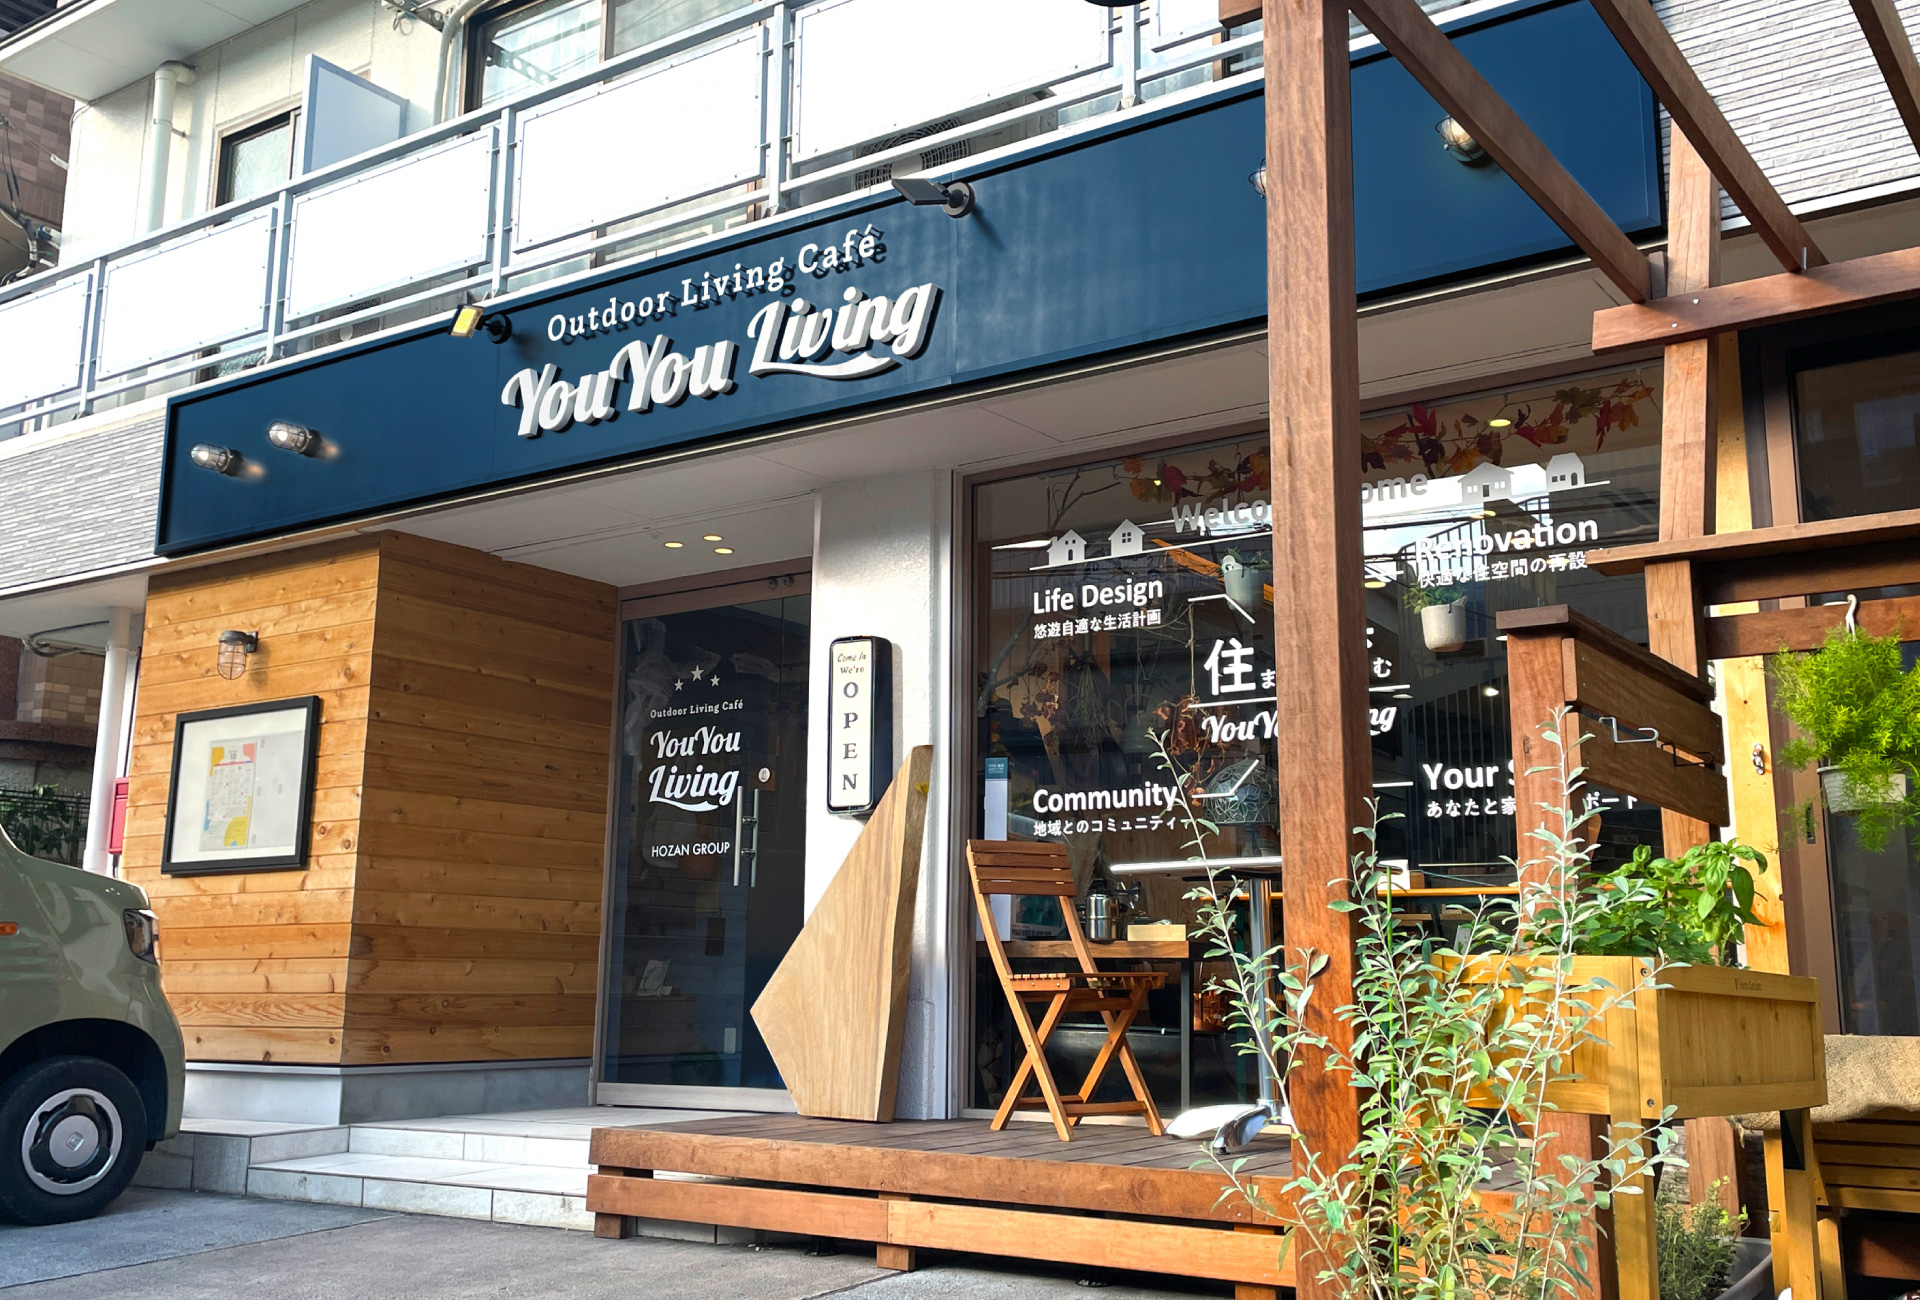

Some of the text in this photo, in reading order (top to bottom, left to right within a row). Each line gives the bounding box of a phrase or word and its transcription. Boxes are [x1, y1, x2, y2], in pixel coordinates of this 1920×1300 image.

[548, 223, 876, 342] Outdoor Living Café
[747, 283, 940, 378] Living
[1171, 473, 1428, 534] Welco ome
[1415, 518, 1599, 563] Renovation
[1417, 549, 1603, 589] 快適な住空間の再設
[1033, 577, 1164, 615] Life Design
[1033, 608, 1162, 640] 悠遊自適な生活計画
[837, 652, 858, 663] Come
[840, 665, 865, 674] We're
[650, 698, 744, 719] Outdoor Living Café
[1201, 709, 1279, 743] YouY
[842, 681, 859, 790] OPEN
[648, 764, 740, 811] Living
[1422, 762, 1500, 791] Your
[1032, 780, 1178, 813] Community
[651, 841, 731, 858] HOZAN GROUP
